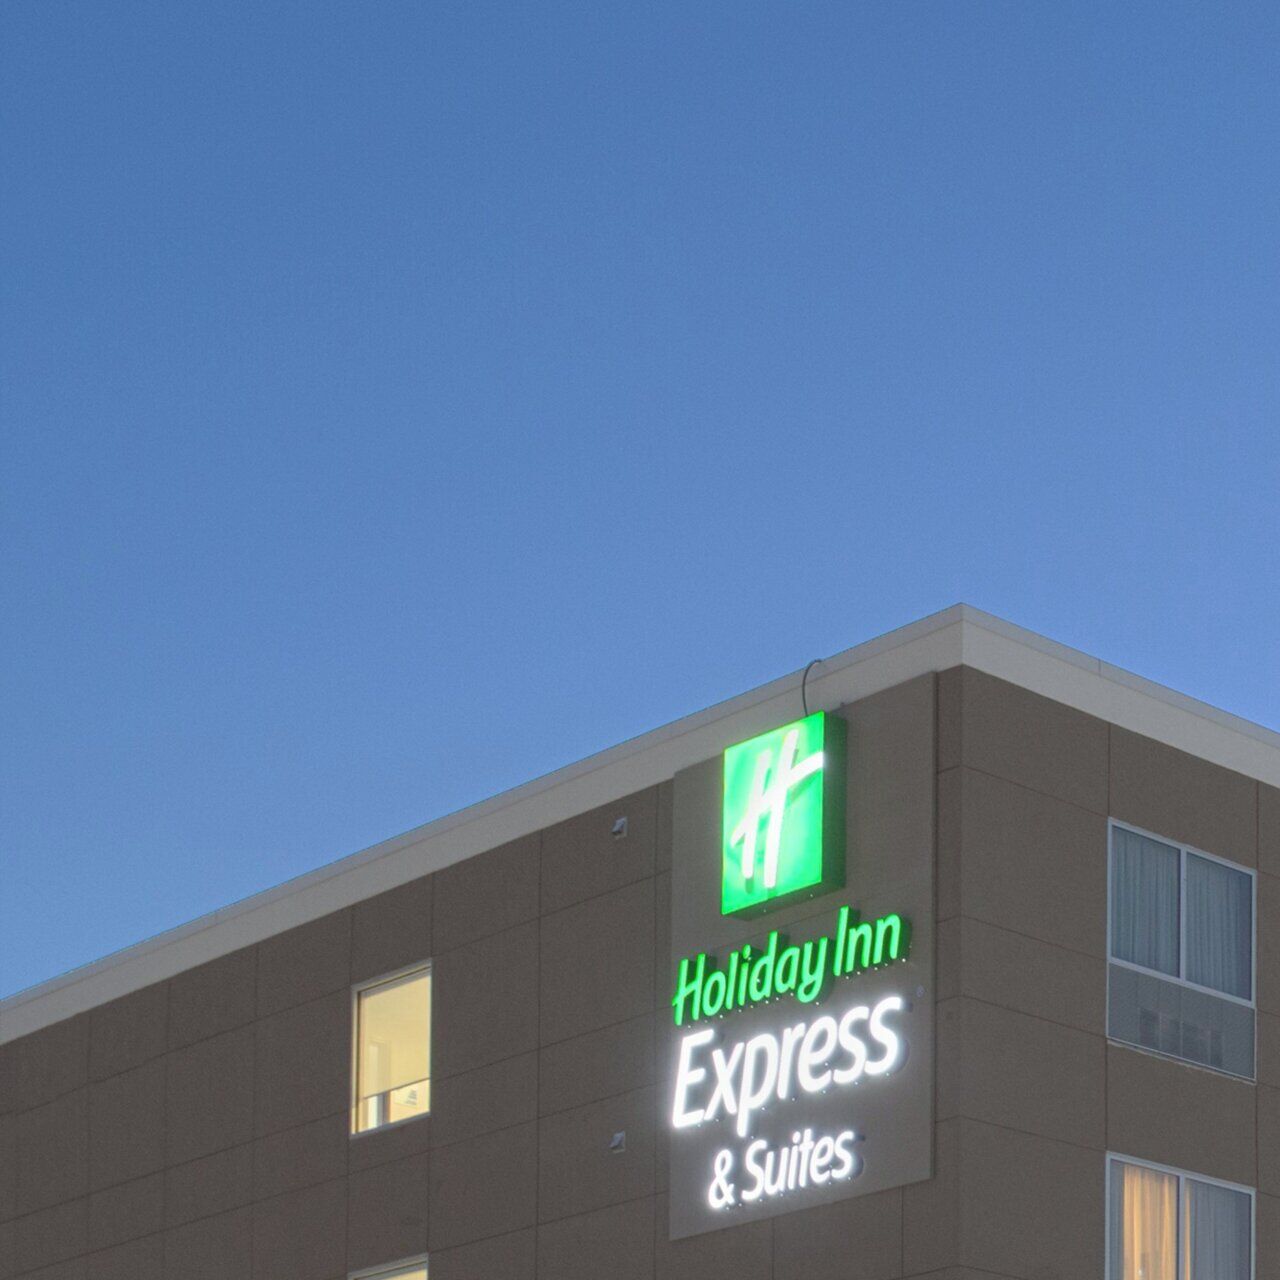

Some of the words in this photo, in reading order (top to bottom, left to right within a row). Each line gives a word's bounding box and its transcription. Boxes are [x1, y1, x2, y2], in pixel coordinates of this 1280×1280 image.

[673, 931, 828, 1026] Holiday
[833, 905, 902, 977] Inn
[671, 995, 903, 1138] Express
[707, 1148, 735, 1210] &
[741, 1128, 856, 1204] Suites
